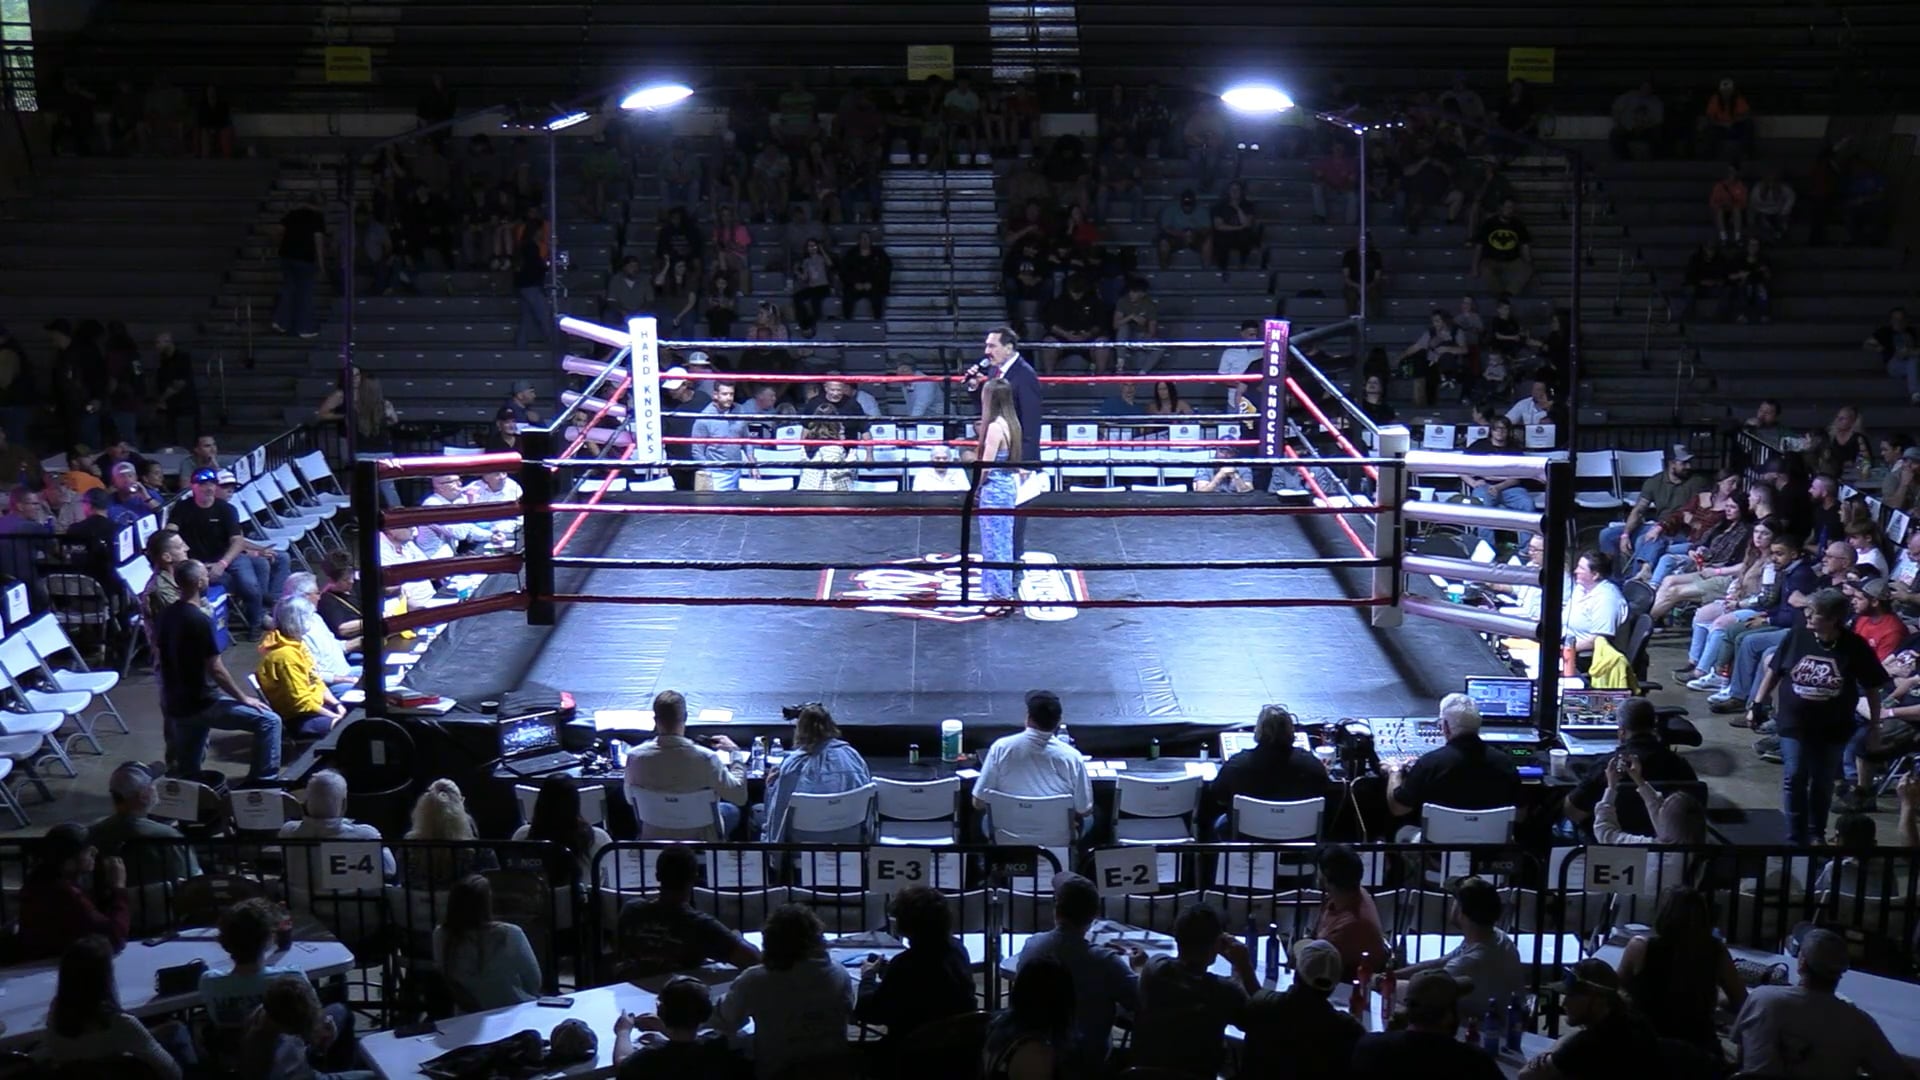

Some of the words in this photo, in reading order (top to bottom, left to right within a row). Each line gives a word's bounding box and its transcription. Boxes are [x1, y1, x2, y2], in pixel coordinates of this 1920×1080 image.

[641, 331, 650, 375] HARD
[1269, 329, 1281, 377] HARD
[644, 386, 654, 454] KNOCKS
[1266, 385, 1277, 456] KNOCKS
[330, 854, 374, 875] E-4
[877, 860, 922, 881] E-3
[1104, 865, 1150, 888] E-2
[1593, 865, 1634, 885] E-1
